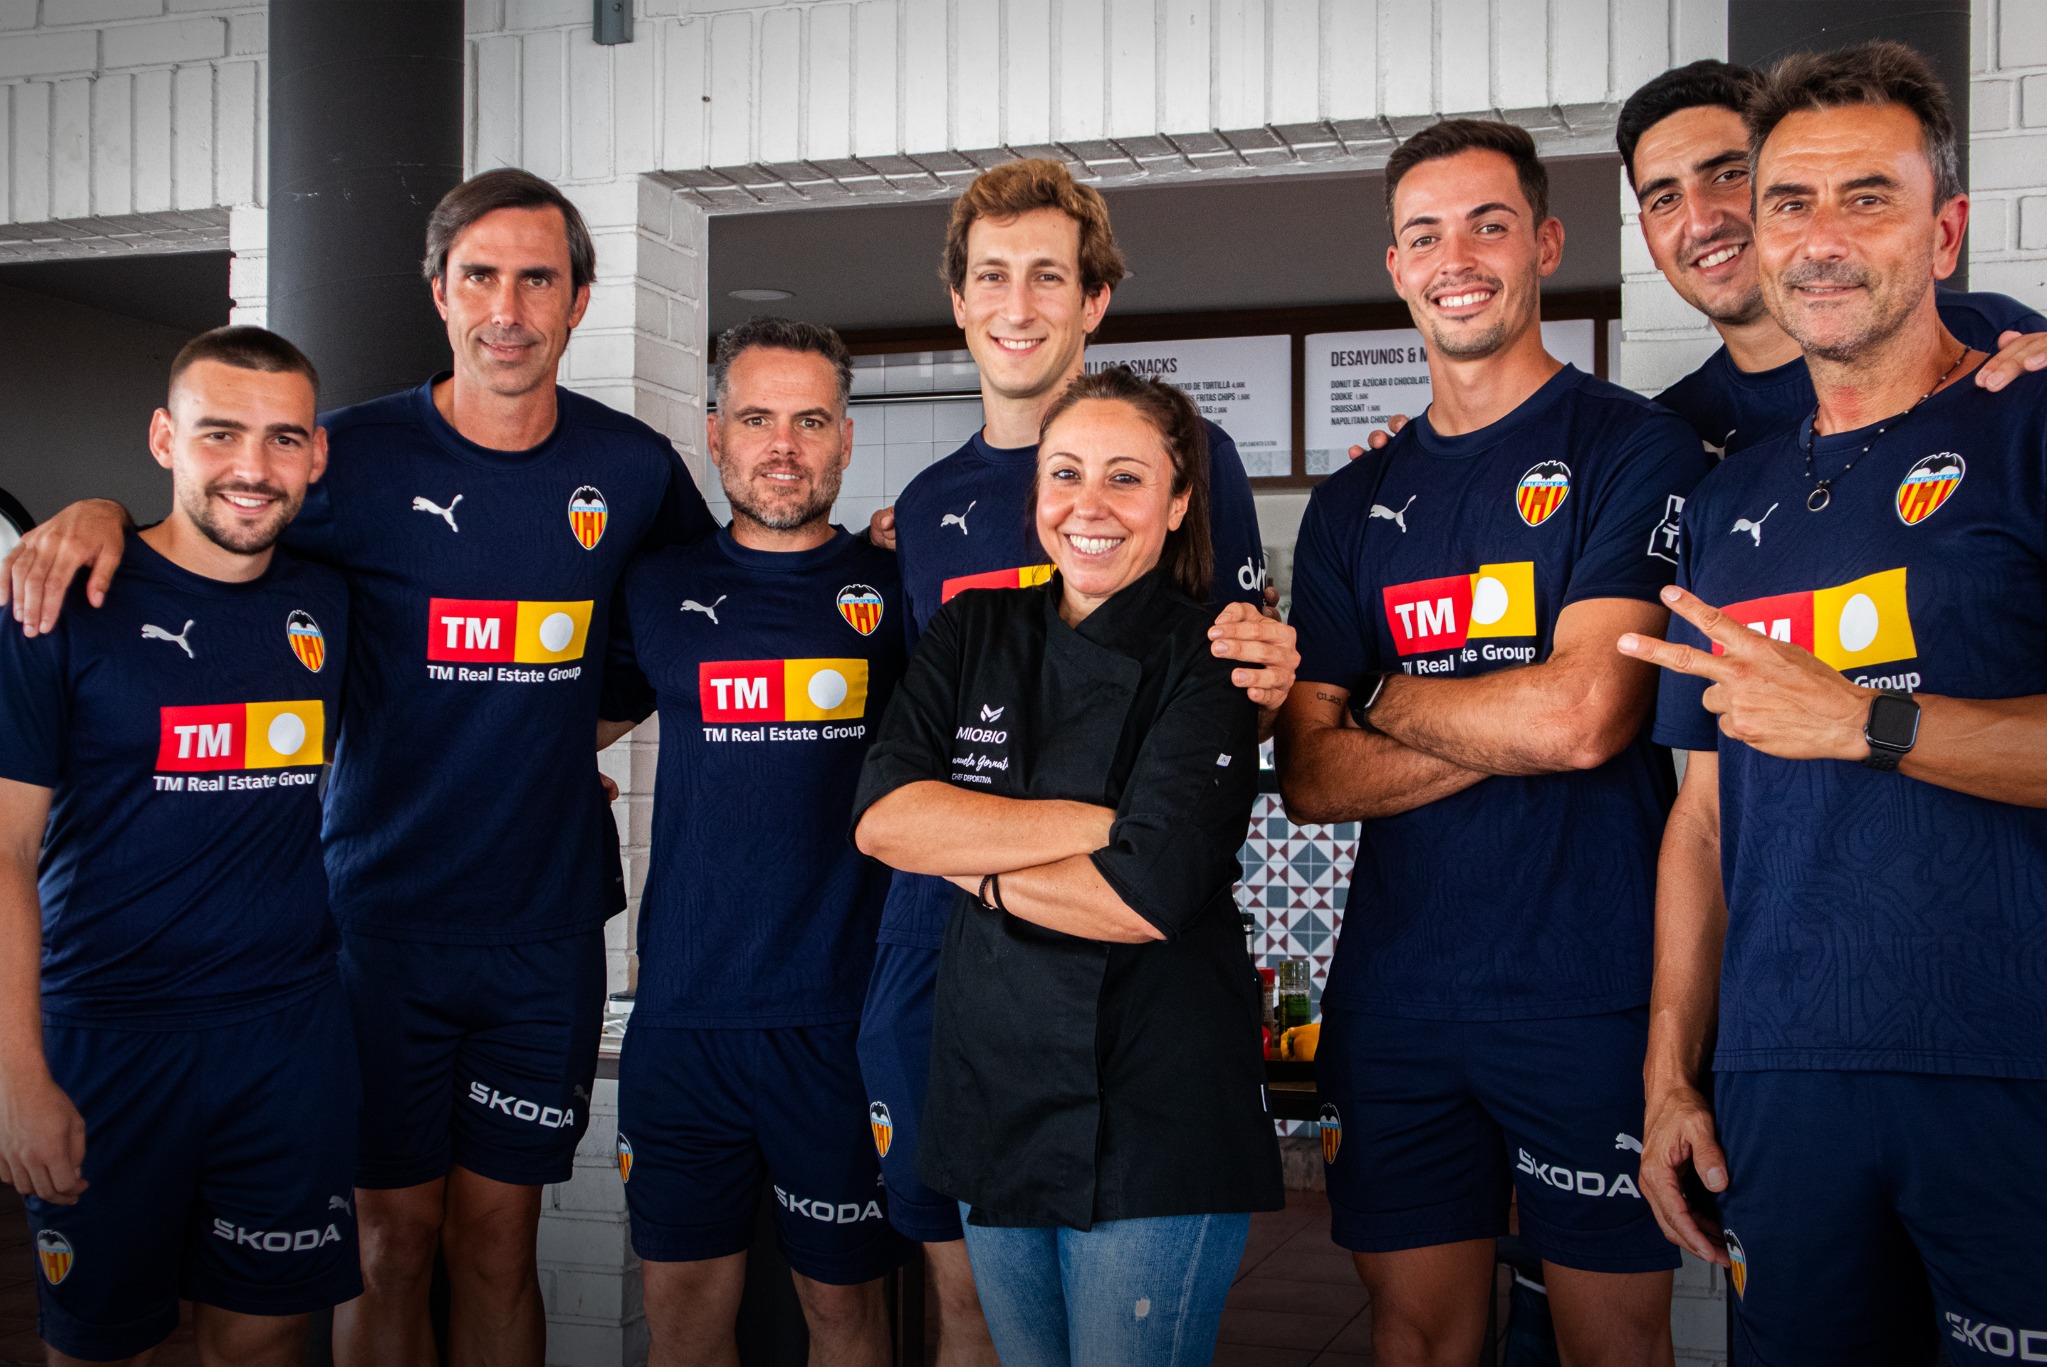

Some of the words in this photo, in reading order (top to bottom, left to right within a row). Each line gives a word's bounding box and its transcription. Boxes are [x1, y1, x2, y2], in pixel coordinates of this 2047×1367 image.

[1331, 348, 1404, 367] DESAYUNOS
[1407, 347, 1416, 363] &
[1130, 358, 1177, 375] SNACKS
[1194, 382, 1201, 390] DE
[1202, 381, 1230, 389] TORTILLA
[1330, 380, 1351, 389] DONUT
[1353, 379, 1361, 388] DE
[1362, 377, 1387, 387] AZÚCAR
[1388, 378, 1393, 386] O
[1394, 376, 1430, 386] CHOCOLATE
[1196, 393, 1217, 401] FRITAS
[1218, 393, 1236, 401] CHIPS
[1330, 392, 1353, 401] COOKIE
[1330, 404, 1365, 413] CROISSANT
[1330, 416, 1369, 425] NAPOLITANA
[1395, 597, 1456, 639] TM
[441, 616, 500, 649] TM
[1743, 618, 1791, 643] M
[1482, 644, 1536, 663] Group
[1417, 655, 1455, 675] Real
[427, 665, 454, 680] TM
[458, 667, 493, 681] Real
[497, 667, 545, 683] Estate
[548, 666, 581, 682] Group
[1854, 672, 1920, 693] Group
[710, 677, 768, 710] TM
[174, 723, 232, 759] TM
[703, 728, 727, 742] TM
[731, 727, 765, 742] Real
[769, 727, 818, 742] Estate
[822, 725, 866, 740] Group
[956, 727, 1007, 744] MIOBIO
[976, 754, 1009, 771] Gornat
[153, 776, 184, 791] TM
[187, 775, 223, 792] Real
[228, 774, 276, 790] Estate
[278, 772, 317, 786] Grou
[963, 774, 992, 784] DEPORTIVA
